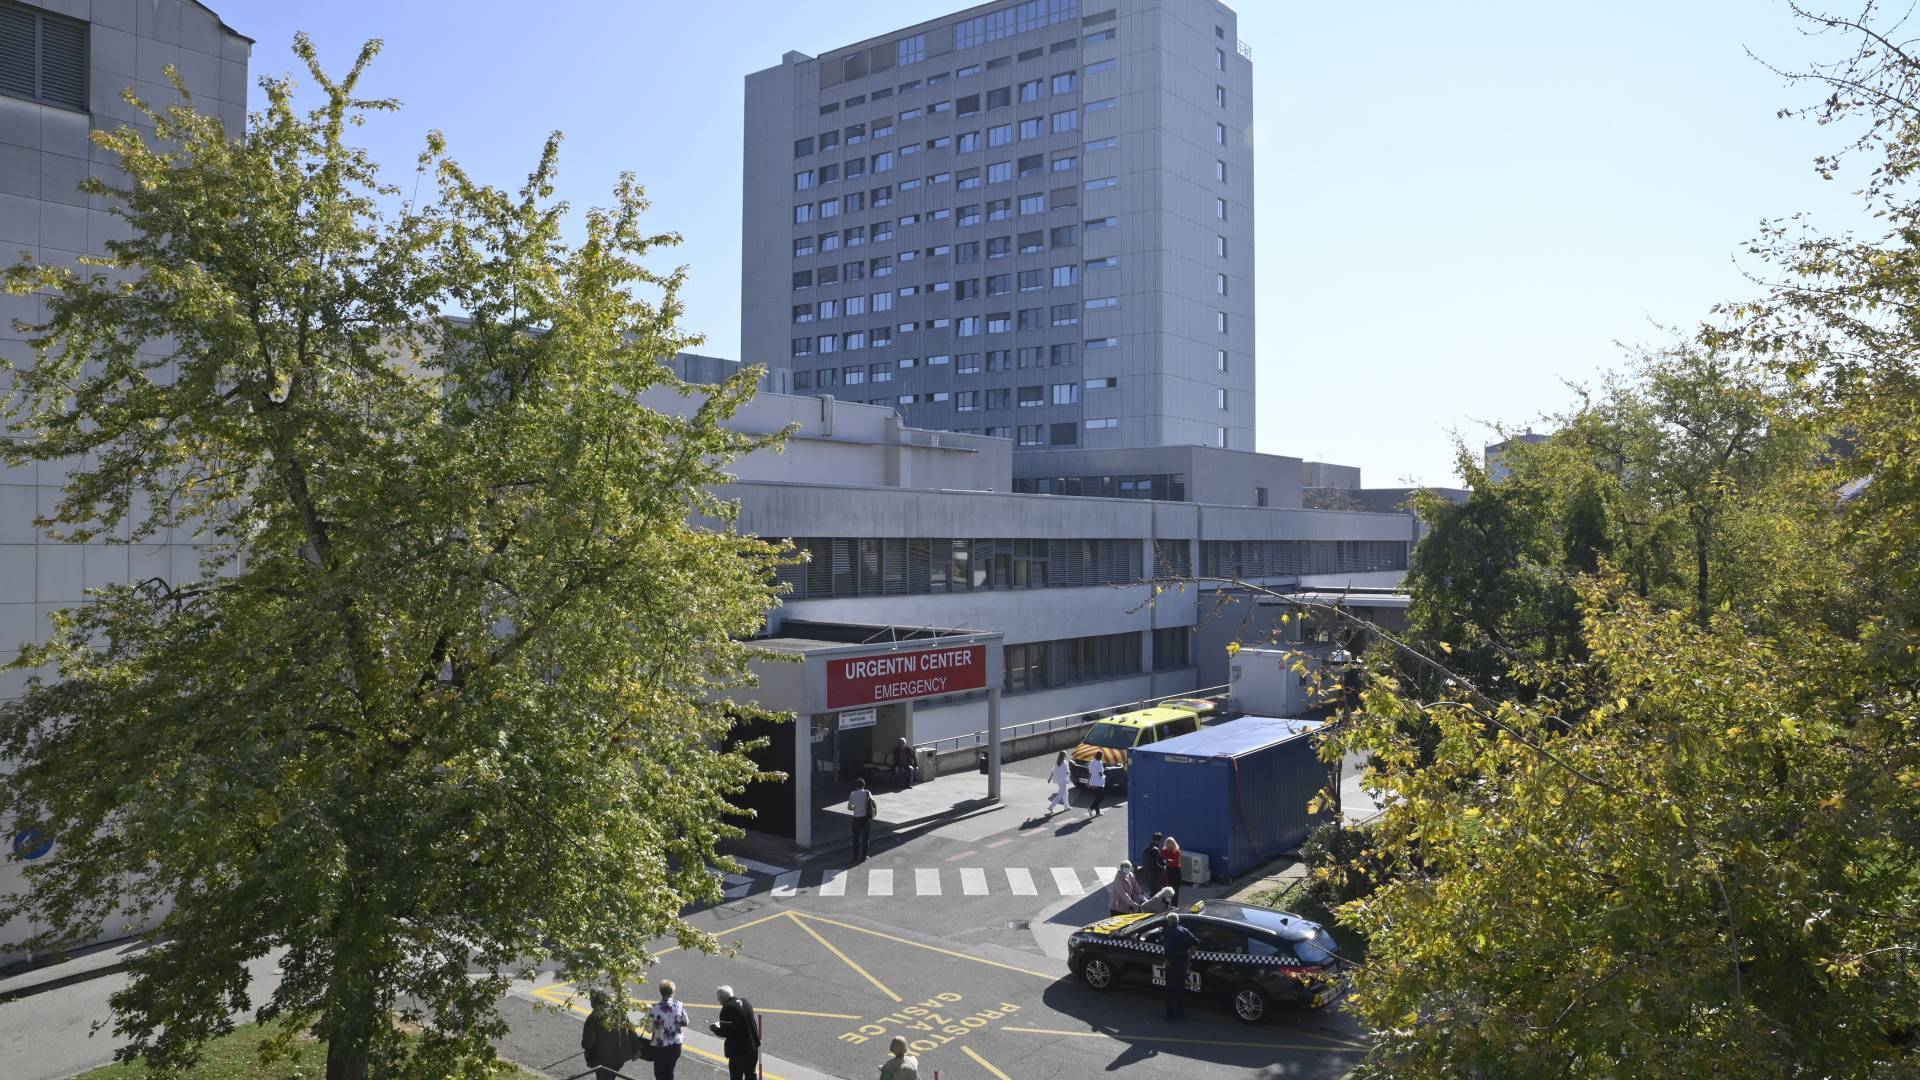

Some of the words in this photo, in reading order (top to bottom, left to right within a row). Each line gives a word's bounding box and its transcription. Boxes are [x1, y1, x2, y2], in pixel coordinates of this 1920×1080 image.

[845, 657, 916, 680] URGENTNI
[920, 650, 971, 670] CENTER
[874, 677, 947, 699] EMERGENCY
[838, 992, 963, 1045] GASILCE
[905, 1013, 953, 1031] ZA
